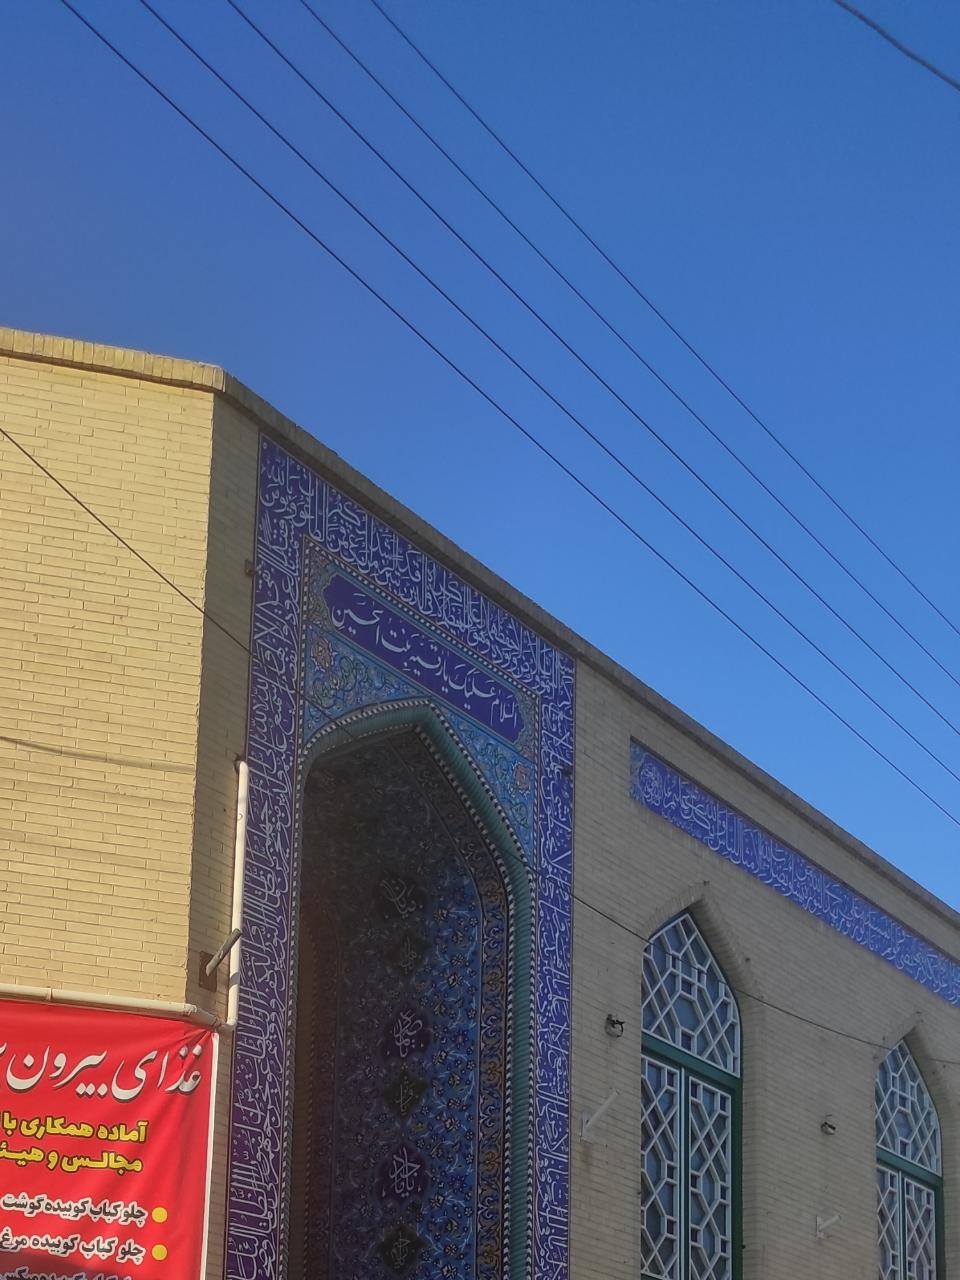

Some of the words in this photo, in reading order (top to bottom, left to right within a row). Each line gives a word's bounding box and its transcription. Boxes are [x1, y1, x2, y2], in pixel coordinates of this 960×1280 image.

[6, 1045, 108, 1096] بیرون
[112, 1044, 202, 1101] غذای
[3, 1111, 17, 1136] با
[20, 1116, 93, 1139] همکاری
[97, 1121, 149, 1142] آماده
[48, 1150, 59, 1170] و
[61, 1151, 143, 1175] مجالس
[0, 1192, 44, 1217] گوشت
[44, 1197, 91, 1220] کوبیده
[90, 1199, 122, 1223] کباب
[120, 1201, 148, 1227] چلو
[30, 1233, 80, 1258] کوبیده
[80, 1234, 117, 1259] کباب
[116, 1239, 146, 1264] چلو
